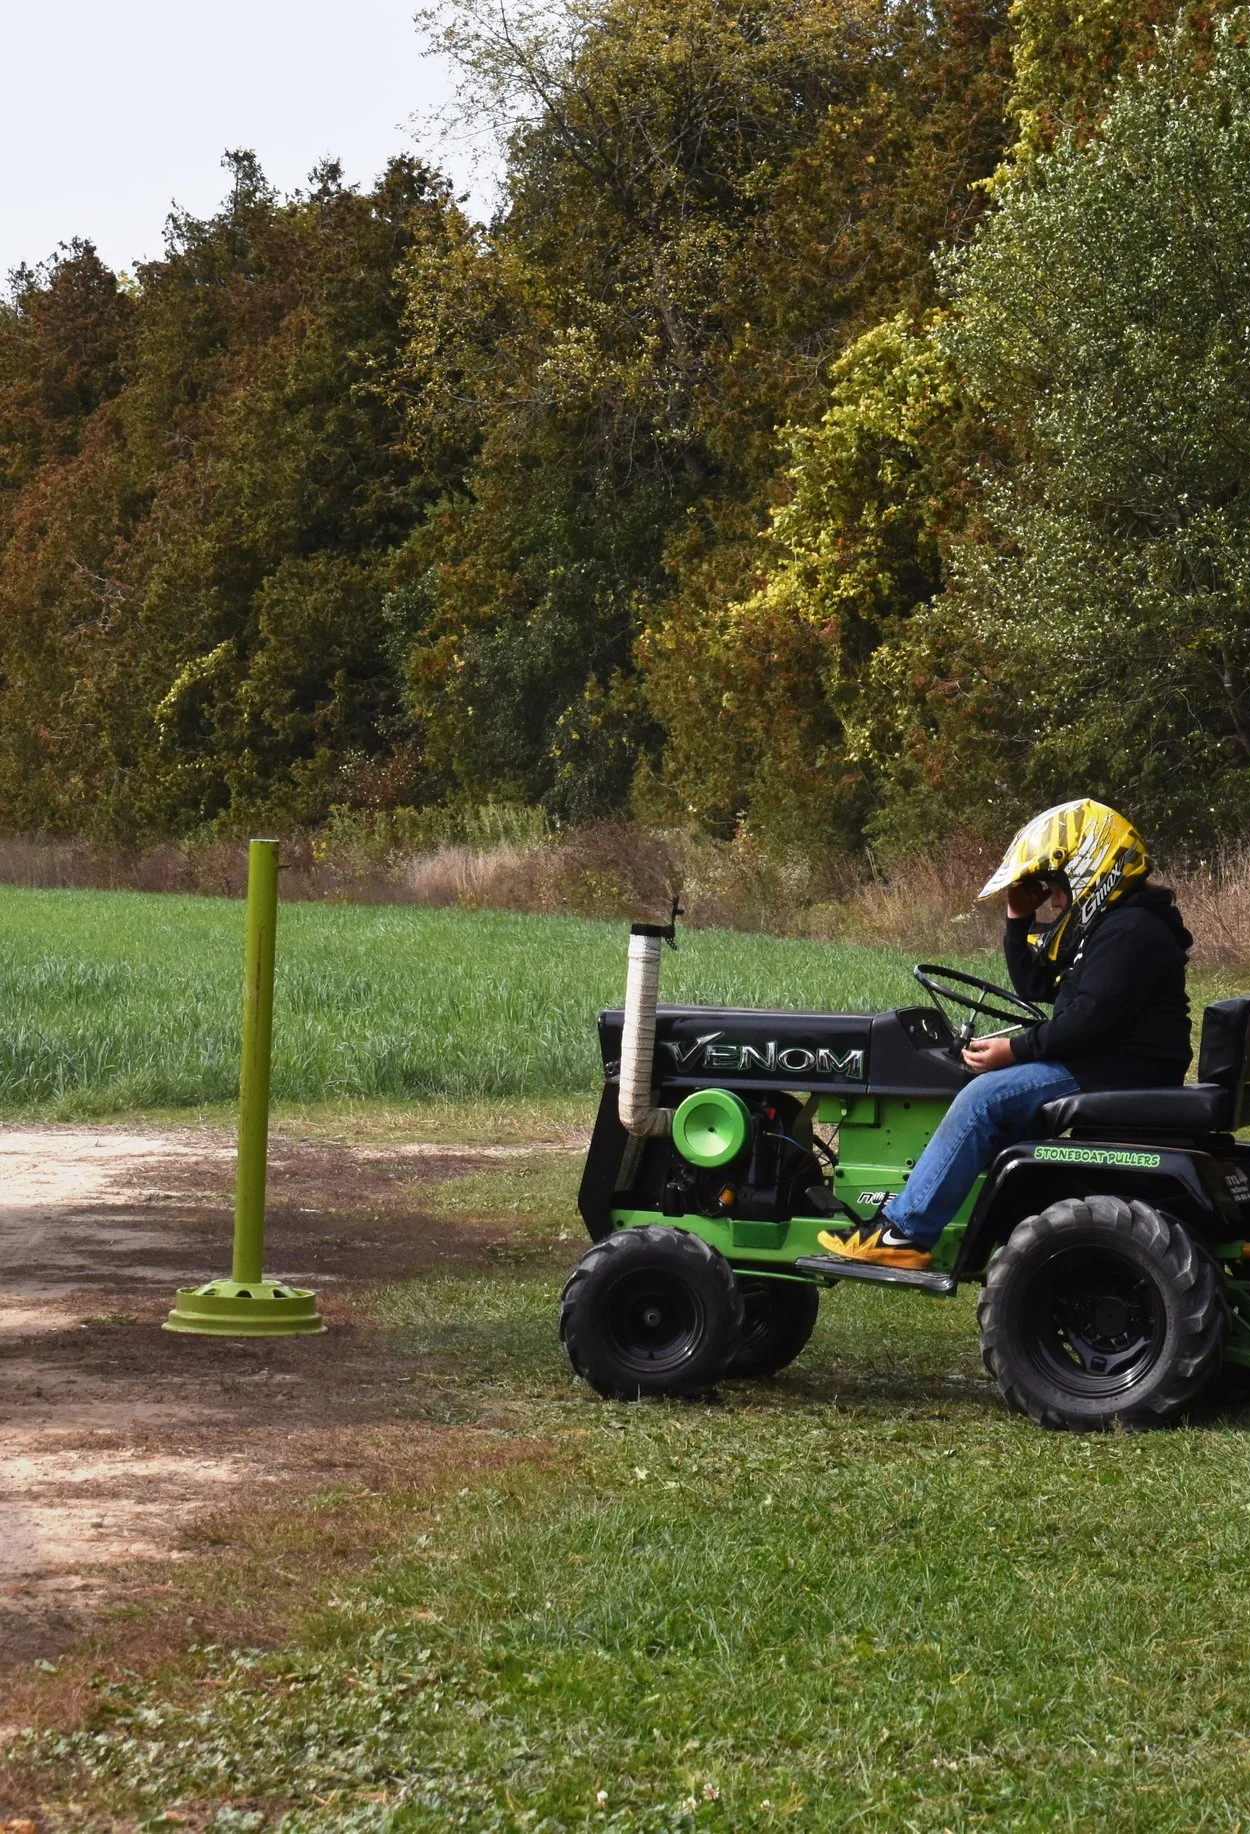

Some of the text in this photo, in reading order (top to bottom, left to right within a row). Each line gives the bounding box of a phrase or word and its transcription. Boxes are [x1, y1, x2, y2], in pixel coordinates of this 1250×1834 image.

[660, 1031, 864, 1079] VENOM
[1034, 1146, 1160, 1168] STONEBOAT PULLERS
